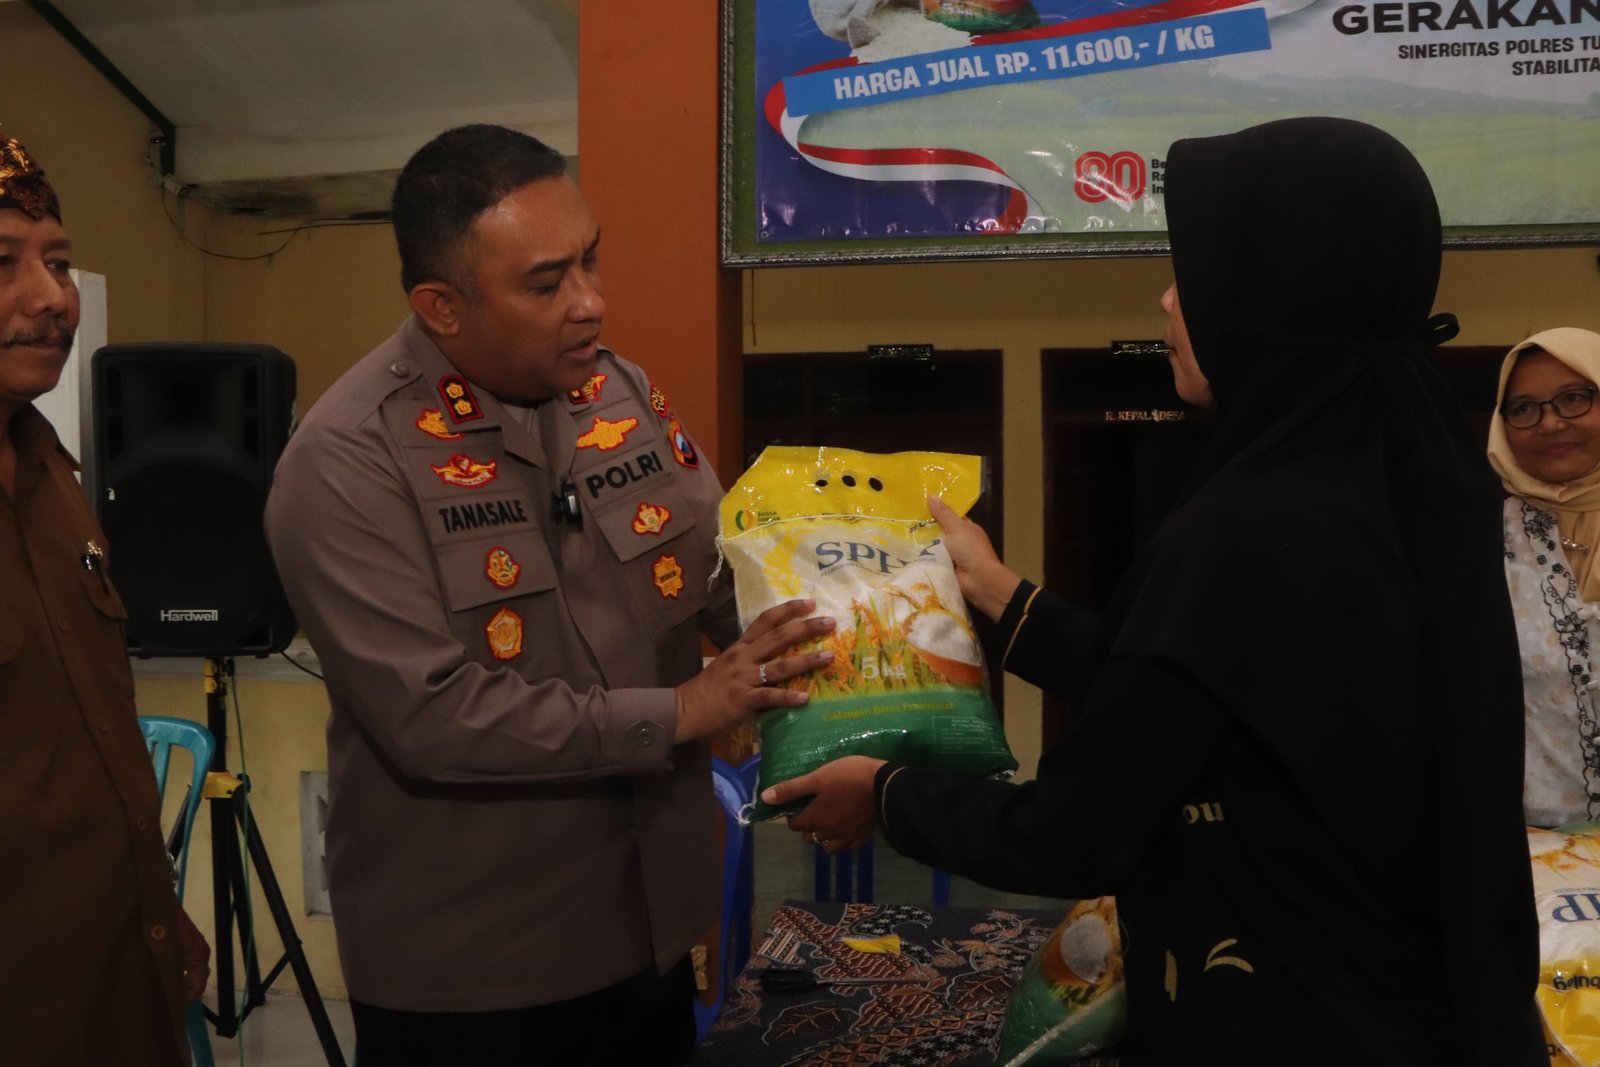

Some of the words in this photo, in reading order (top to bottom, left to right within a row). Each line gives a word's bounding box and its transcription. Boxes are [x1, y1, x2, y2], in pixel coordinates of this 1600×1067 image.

[1332, 0, 1600, 35] GERAKAN
[833, 67, 921, 100] HARGA
[927, 53, 989, 86] JUAL
[996, 52, 1037, 76] RP.
[1041, 35, 1149, 69] 11.600,-
[1175, 25, 1215, 51] KG
[1398, 41, 1499, 59] SINERGITAS
[1506, 37, 1574, 55] POLRES
[1074, 151, 1147, 203] 80
[586, 451, 664, 498] POLRI
[439, 500, 528, 533] TANASALE
[815, 538, 942, 574] SP
[160, 609, 218, 621] Hardwell
[862, 656, 880, 679] 5
